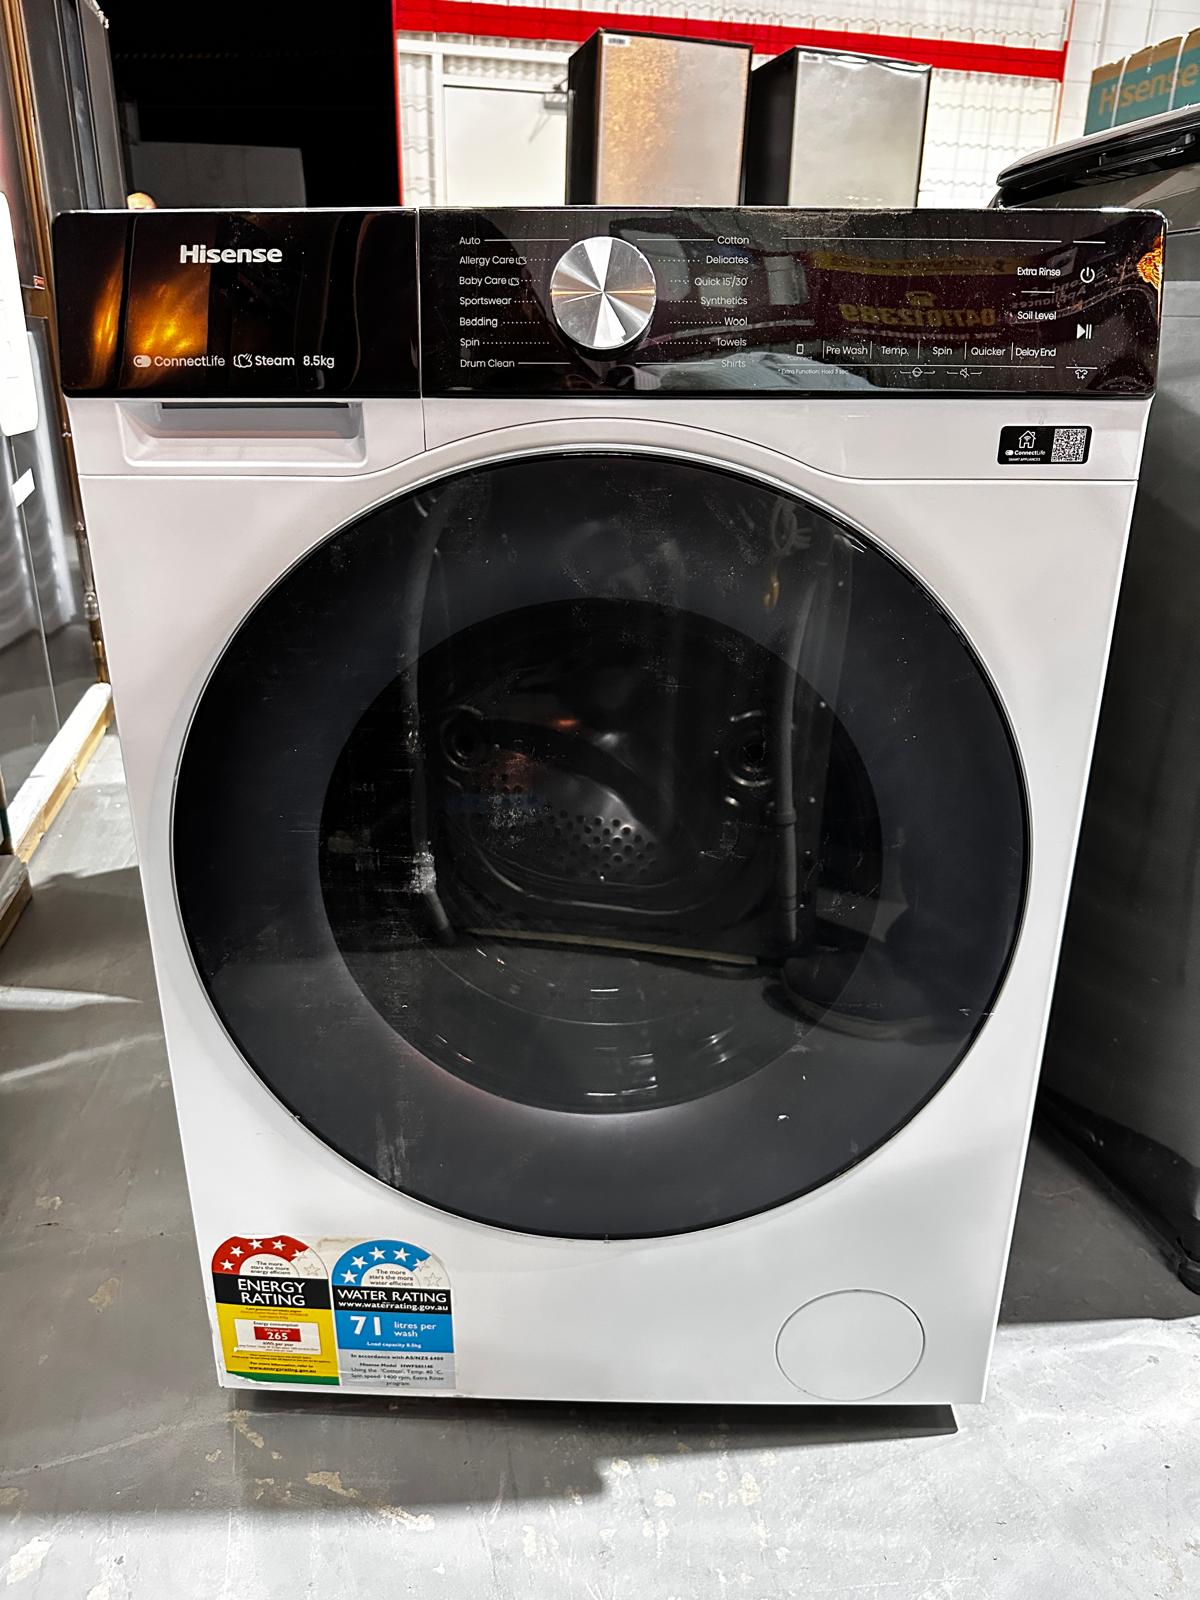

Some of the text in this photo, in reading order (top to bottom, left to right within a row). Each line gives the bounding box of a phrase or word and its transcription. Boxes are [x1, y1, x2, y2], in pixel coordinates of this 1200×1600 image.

[1098, 63, 1200, 117] Hsense
[459, 236, 481, 246] Auto
[717, 236, 750, 245] Cotton
[180, 245, 282, 264] Hisense
[459, 255, 514, 266] Allergy Care
[706, 256, 749, 264] Delicates
[1017, 267, 1061, 277] Extra Rinse
[459, 276, 506, 286] Baby Care
[694, 276, 721, 287] Quick
[460, 296, 512, 307] Sportswear
[700, 296, 748, 306] Synthetics
[1018, 311, 1057, 321] Soil Level
[460, 317, 498, 328] Bedding
[724, 317, 748, 326] Wool
[460, 338, 480, 348] Spin
[716, 338, 747, 347] Towels
[826, 345, 868, 355] Pre Wash
[881, 346, 909, 357] Temp.
[932, 346, 952, 357] Spin
[970, 346, 1006, 357] Quicker
[1015, 347, 1056, 358] Delay End
[154, 355, 225, 368] ConnectLife
[255, 355, 335, 370] Steam 8.5kg
[460, 359, 515, 368] Drum Clean
[721, 359, 746, 368] Shirts
[237, 1278, 306, 1292] ENERGY
[242, 1292, 306, 1306] RATING
[338, 1289, 447, 1303] WATER RATING
[338, 1302, 449, 1312] www.waterrating.gov.au
[394, 1321, 437, 1331] litres per
[267, 1332, 288, 1340] 265
[394, 1329, 418, 1337] wash
